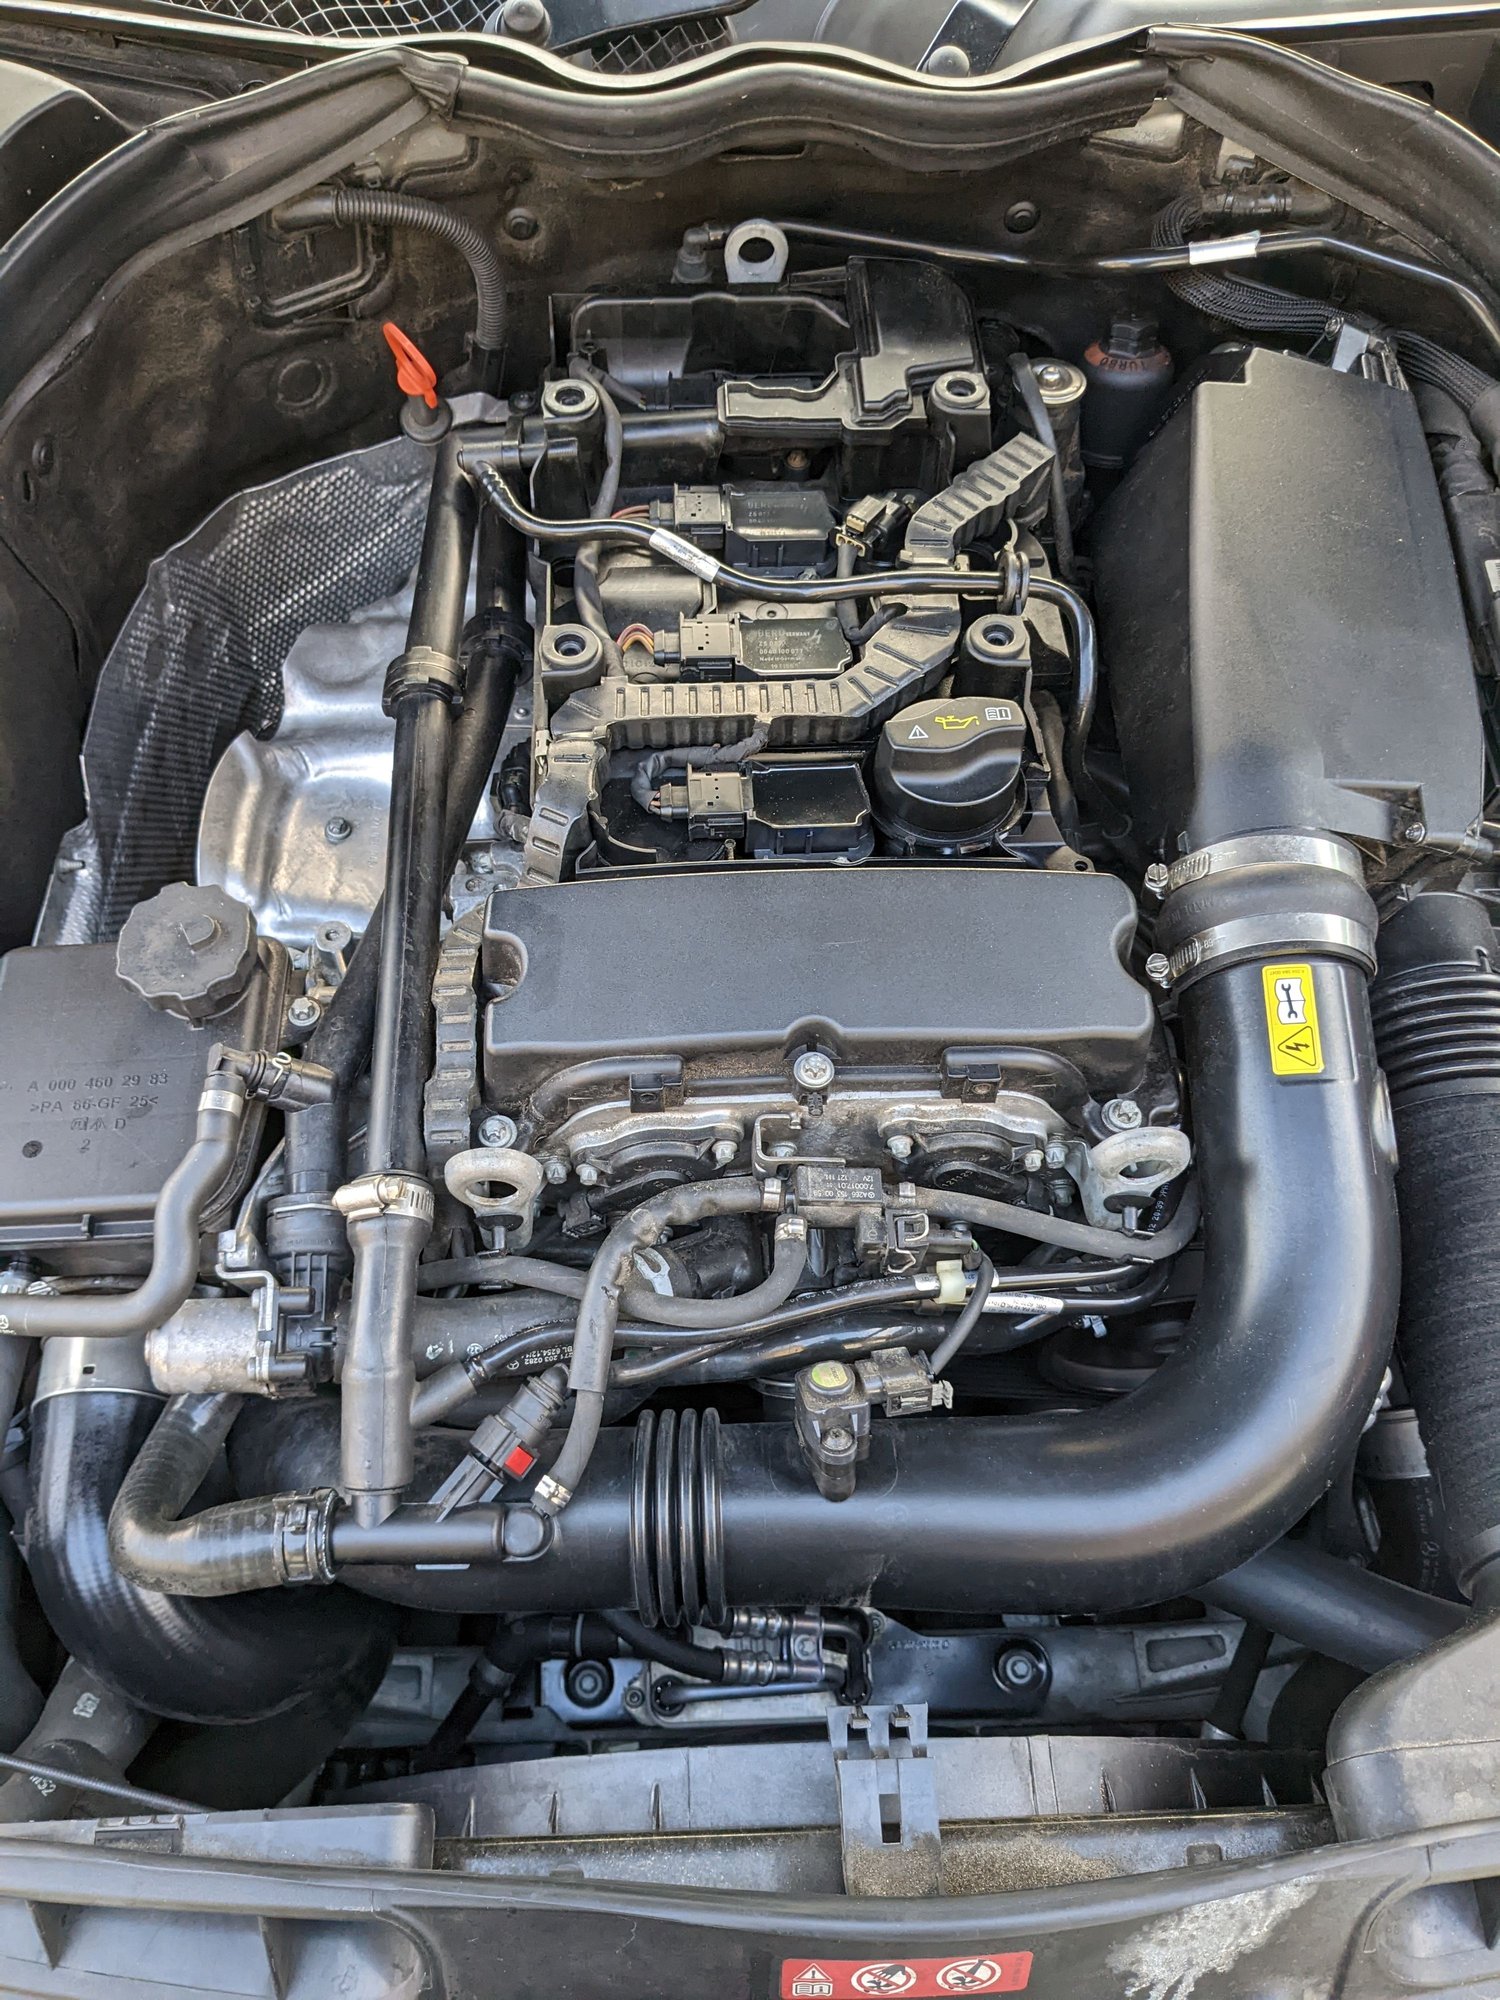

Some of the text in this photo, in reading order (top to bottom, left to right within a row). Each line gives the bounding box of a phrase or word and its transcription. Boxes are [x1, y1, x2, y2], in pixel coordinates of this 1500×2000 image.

[27, 1080, 39, 1092] A
[48, 1078, 76, 1092] 000
[84, 1076, 113, 1089] 460
[121, 1074, 141, 1087] 29
